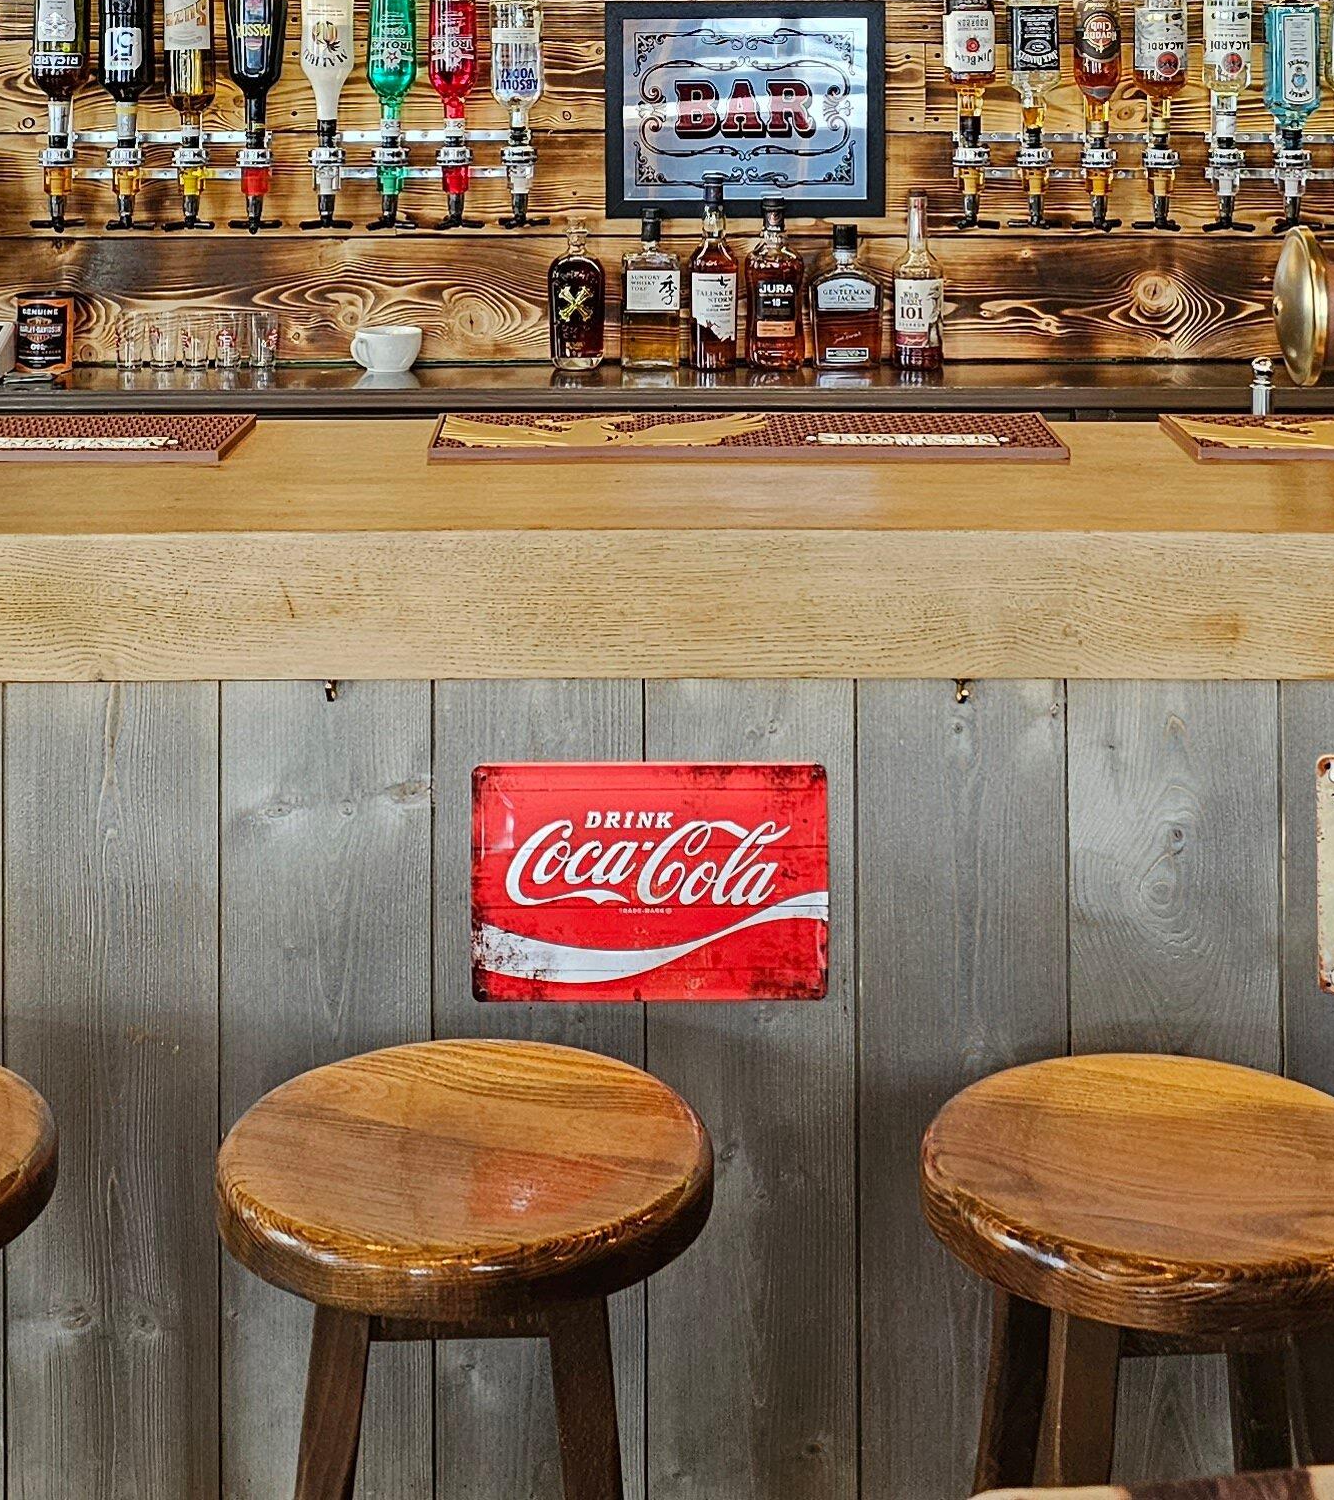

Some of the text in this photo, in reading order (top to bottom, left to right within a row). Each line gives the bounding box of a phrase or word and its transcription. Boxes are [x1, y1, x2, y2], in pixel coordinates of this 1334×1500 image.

[1090, 21, 1111, 31] Club
[1083, 30, 1117, 41] Havana
[110, 31, 135, 61] 51
[34, 54, 80, 66] RICARD
[304, 48, 349, 67] MALIBU
[495, 79, 538, 92] ABSOLUT
[674, 79, 816, 139] BAR
[758, 283, 794, 295] JURA
[823, 288, 871, 296] GENTLEMAN
[22, 308, 59, 316] GENUINE
[900, 307, 923, 320] 101
[585, 811, 674, 829] DRINK
[506, 819, 791, 906] Coca-Cola
